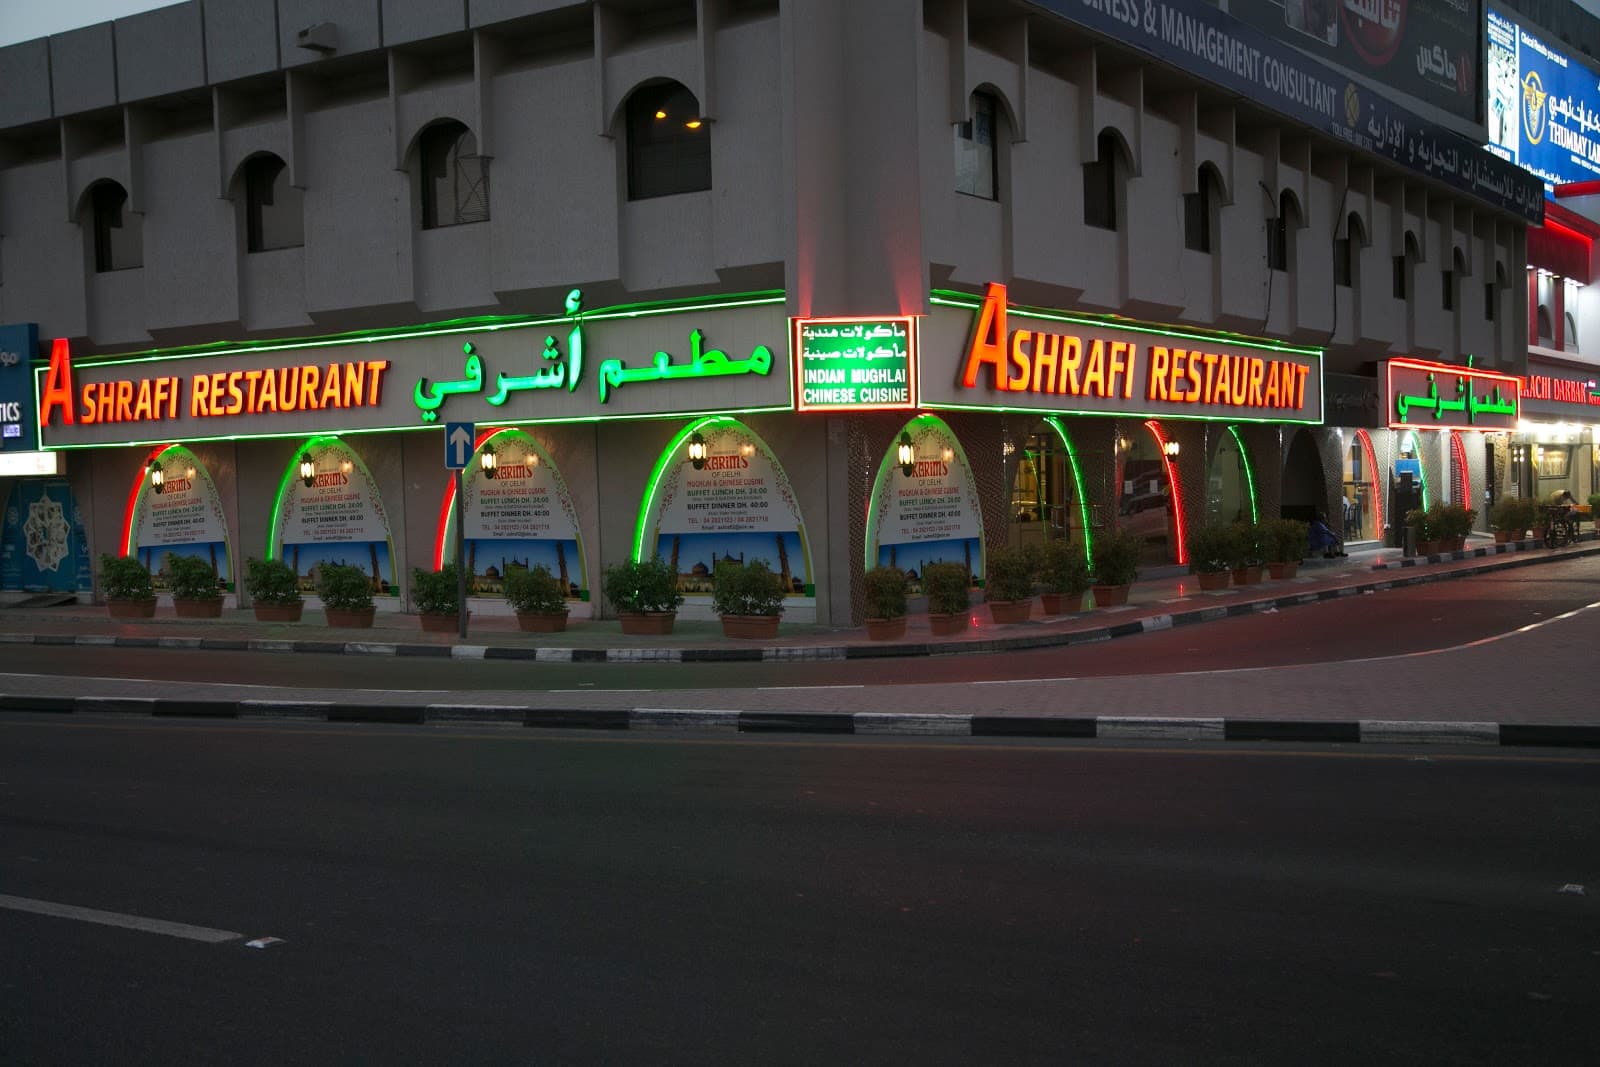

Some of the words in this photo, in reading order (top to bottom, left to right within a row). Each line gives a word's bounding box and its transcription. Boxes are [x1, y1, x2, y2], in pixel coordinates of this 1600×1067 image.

[1161, 4, 1261, 83] MANAGEMENT
[1264, 55, 1337, 118] CONSULTANT
[1548, 119, 1588, 158] THUMBAY
[802, 326, 839, 340] هندية
[962, 281, 1137, 400] ASHRAFI
[1148, 345, 1310, 410] RESTAURANT
[414, 289, 585, 423] أشرفي
[599, 328, 773, 404] مطعم
[803, 347, 842, 361] صينية
[40, 337, 180, 427] ASHRAFI
[191, 360, 389, 417] RESTAURANT
[803, 388, 857, 403] CHINESE
[860, 387, 909, 403] CUISINE
[804, 368, 846, 384] INDIAN
[851, 368, 906, 384] MUGHLAI
[1398, 354, 1473, 424] أشرفي
[1553, 378, 1586, 403] DARBAR
[1471, 384, 1517, 425] مطعم
[712, 488, 734, 496] LUNCH
